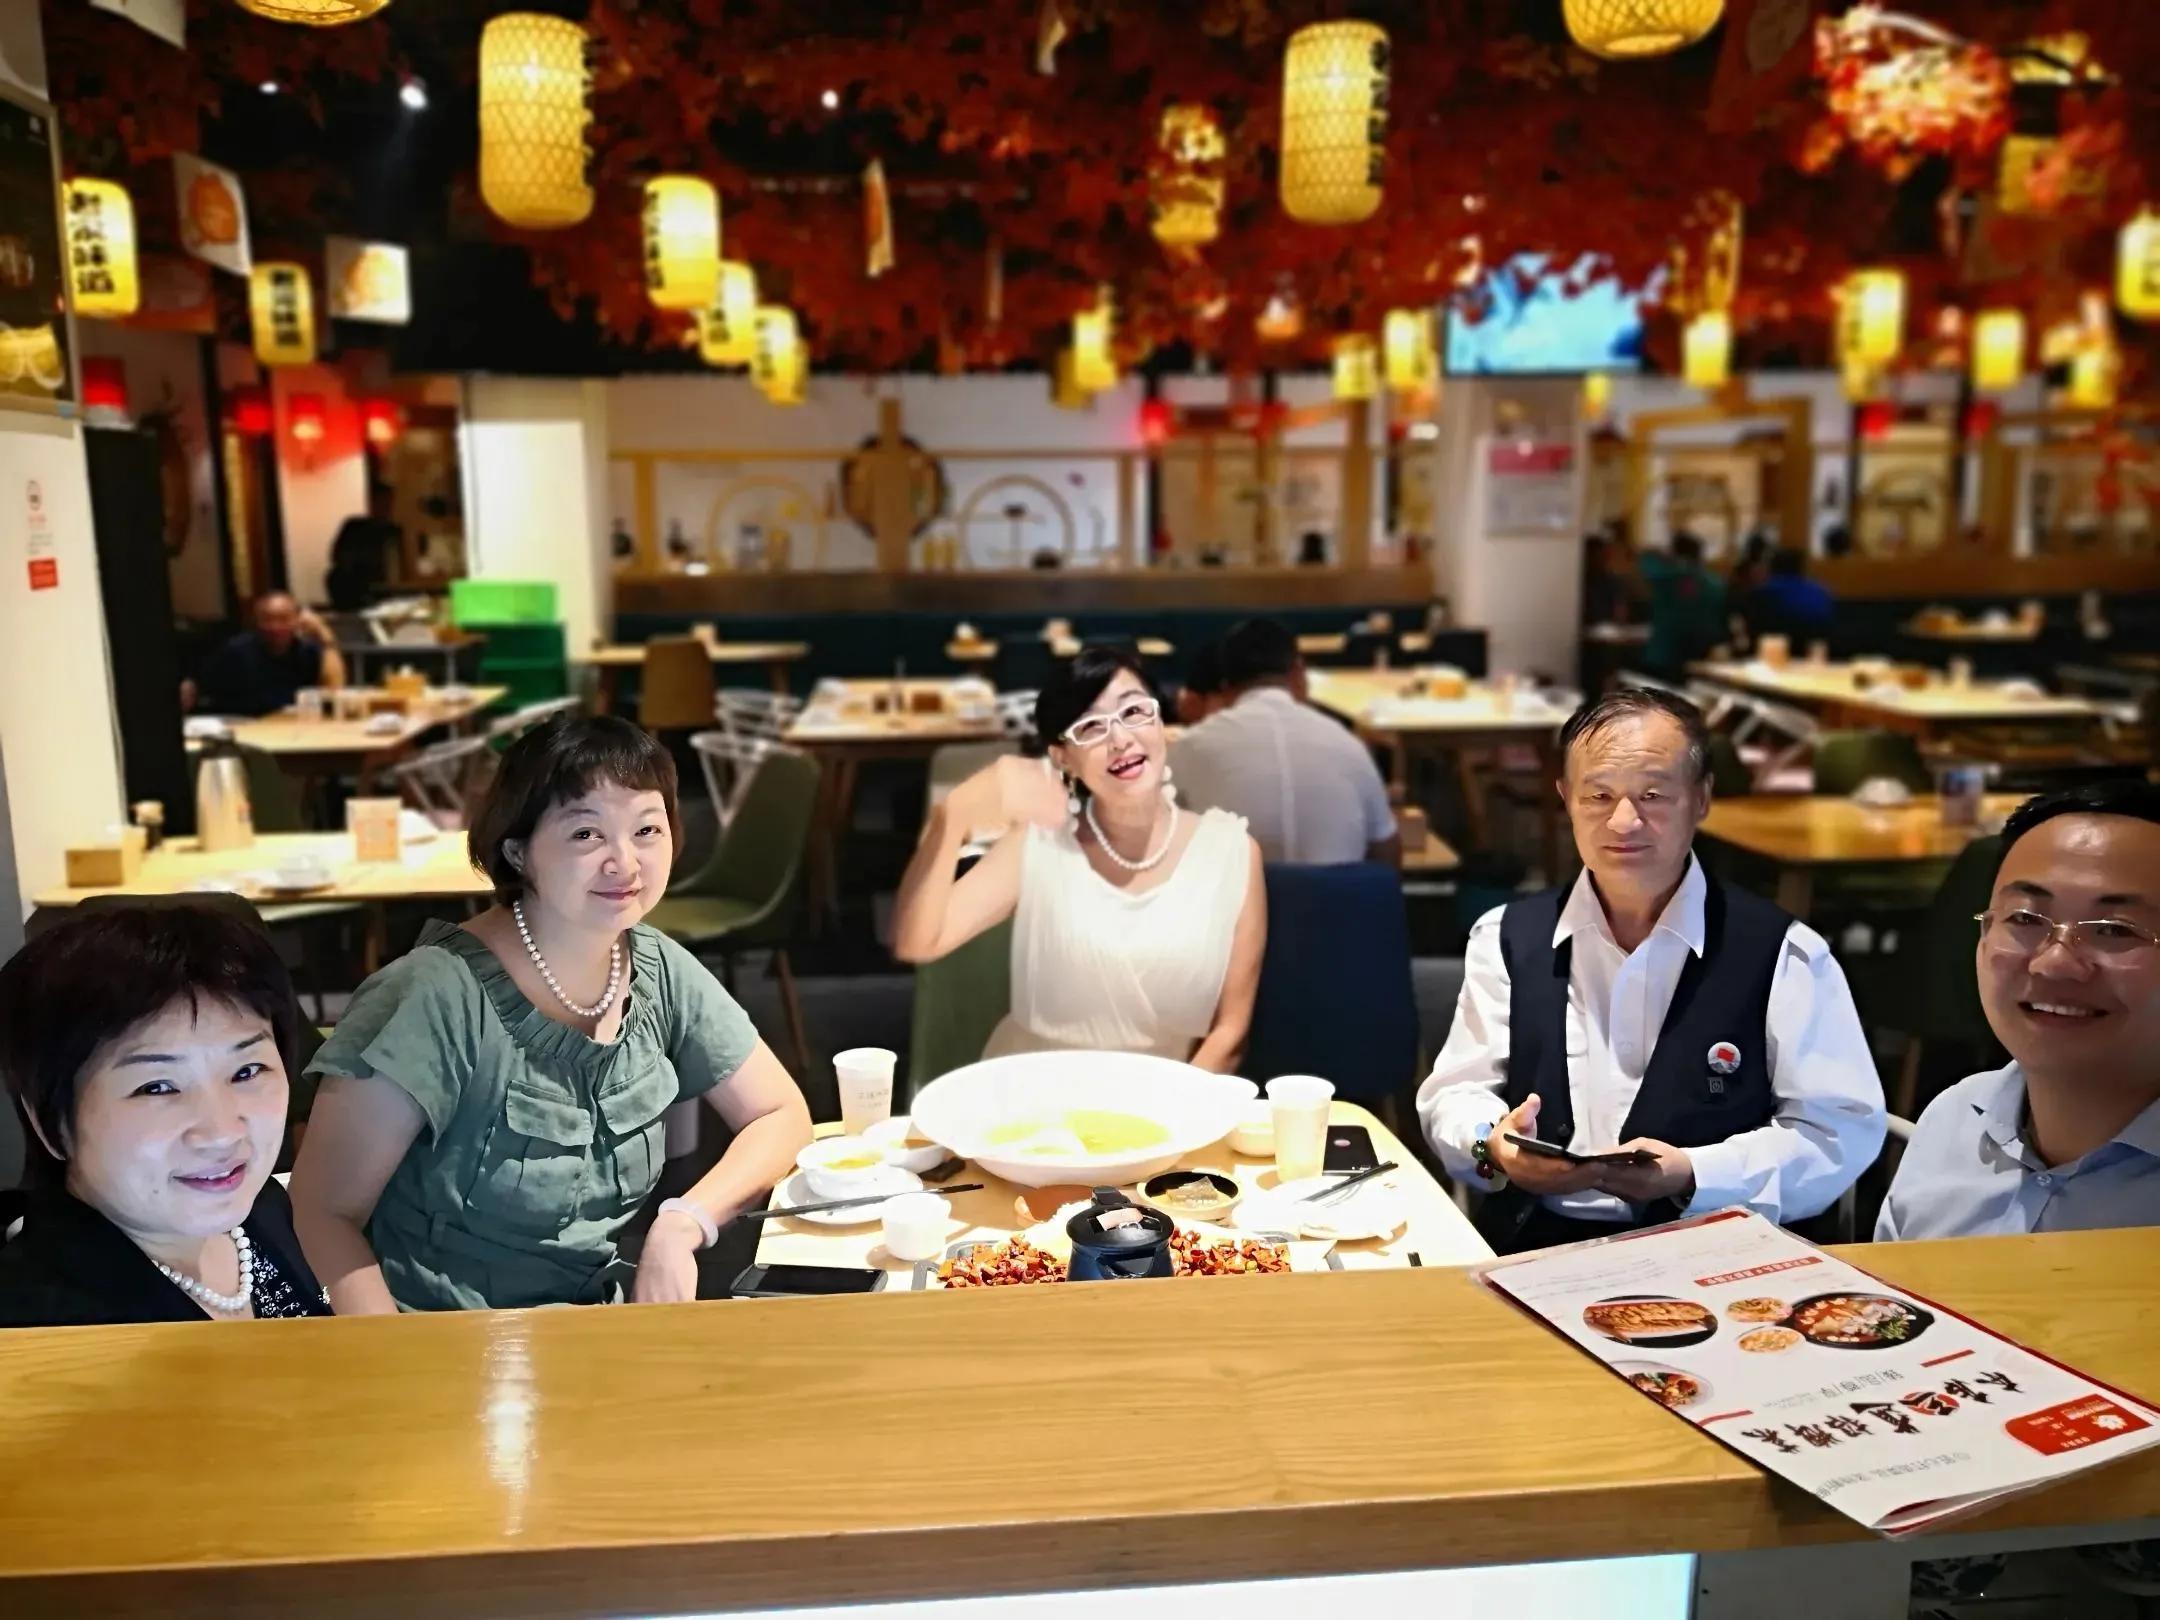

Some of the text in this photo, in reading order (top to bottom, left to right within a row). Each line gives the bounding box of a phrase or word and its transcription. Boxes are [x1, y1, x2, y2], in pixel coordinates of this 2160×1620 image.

[1741, 1370, 2025, 1454] 本店三道招牌菜
